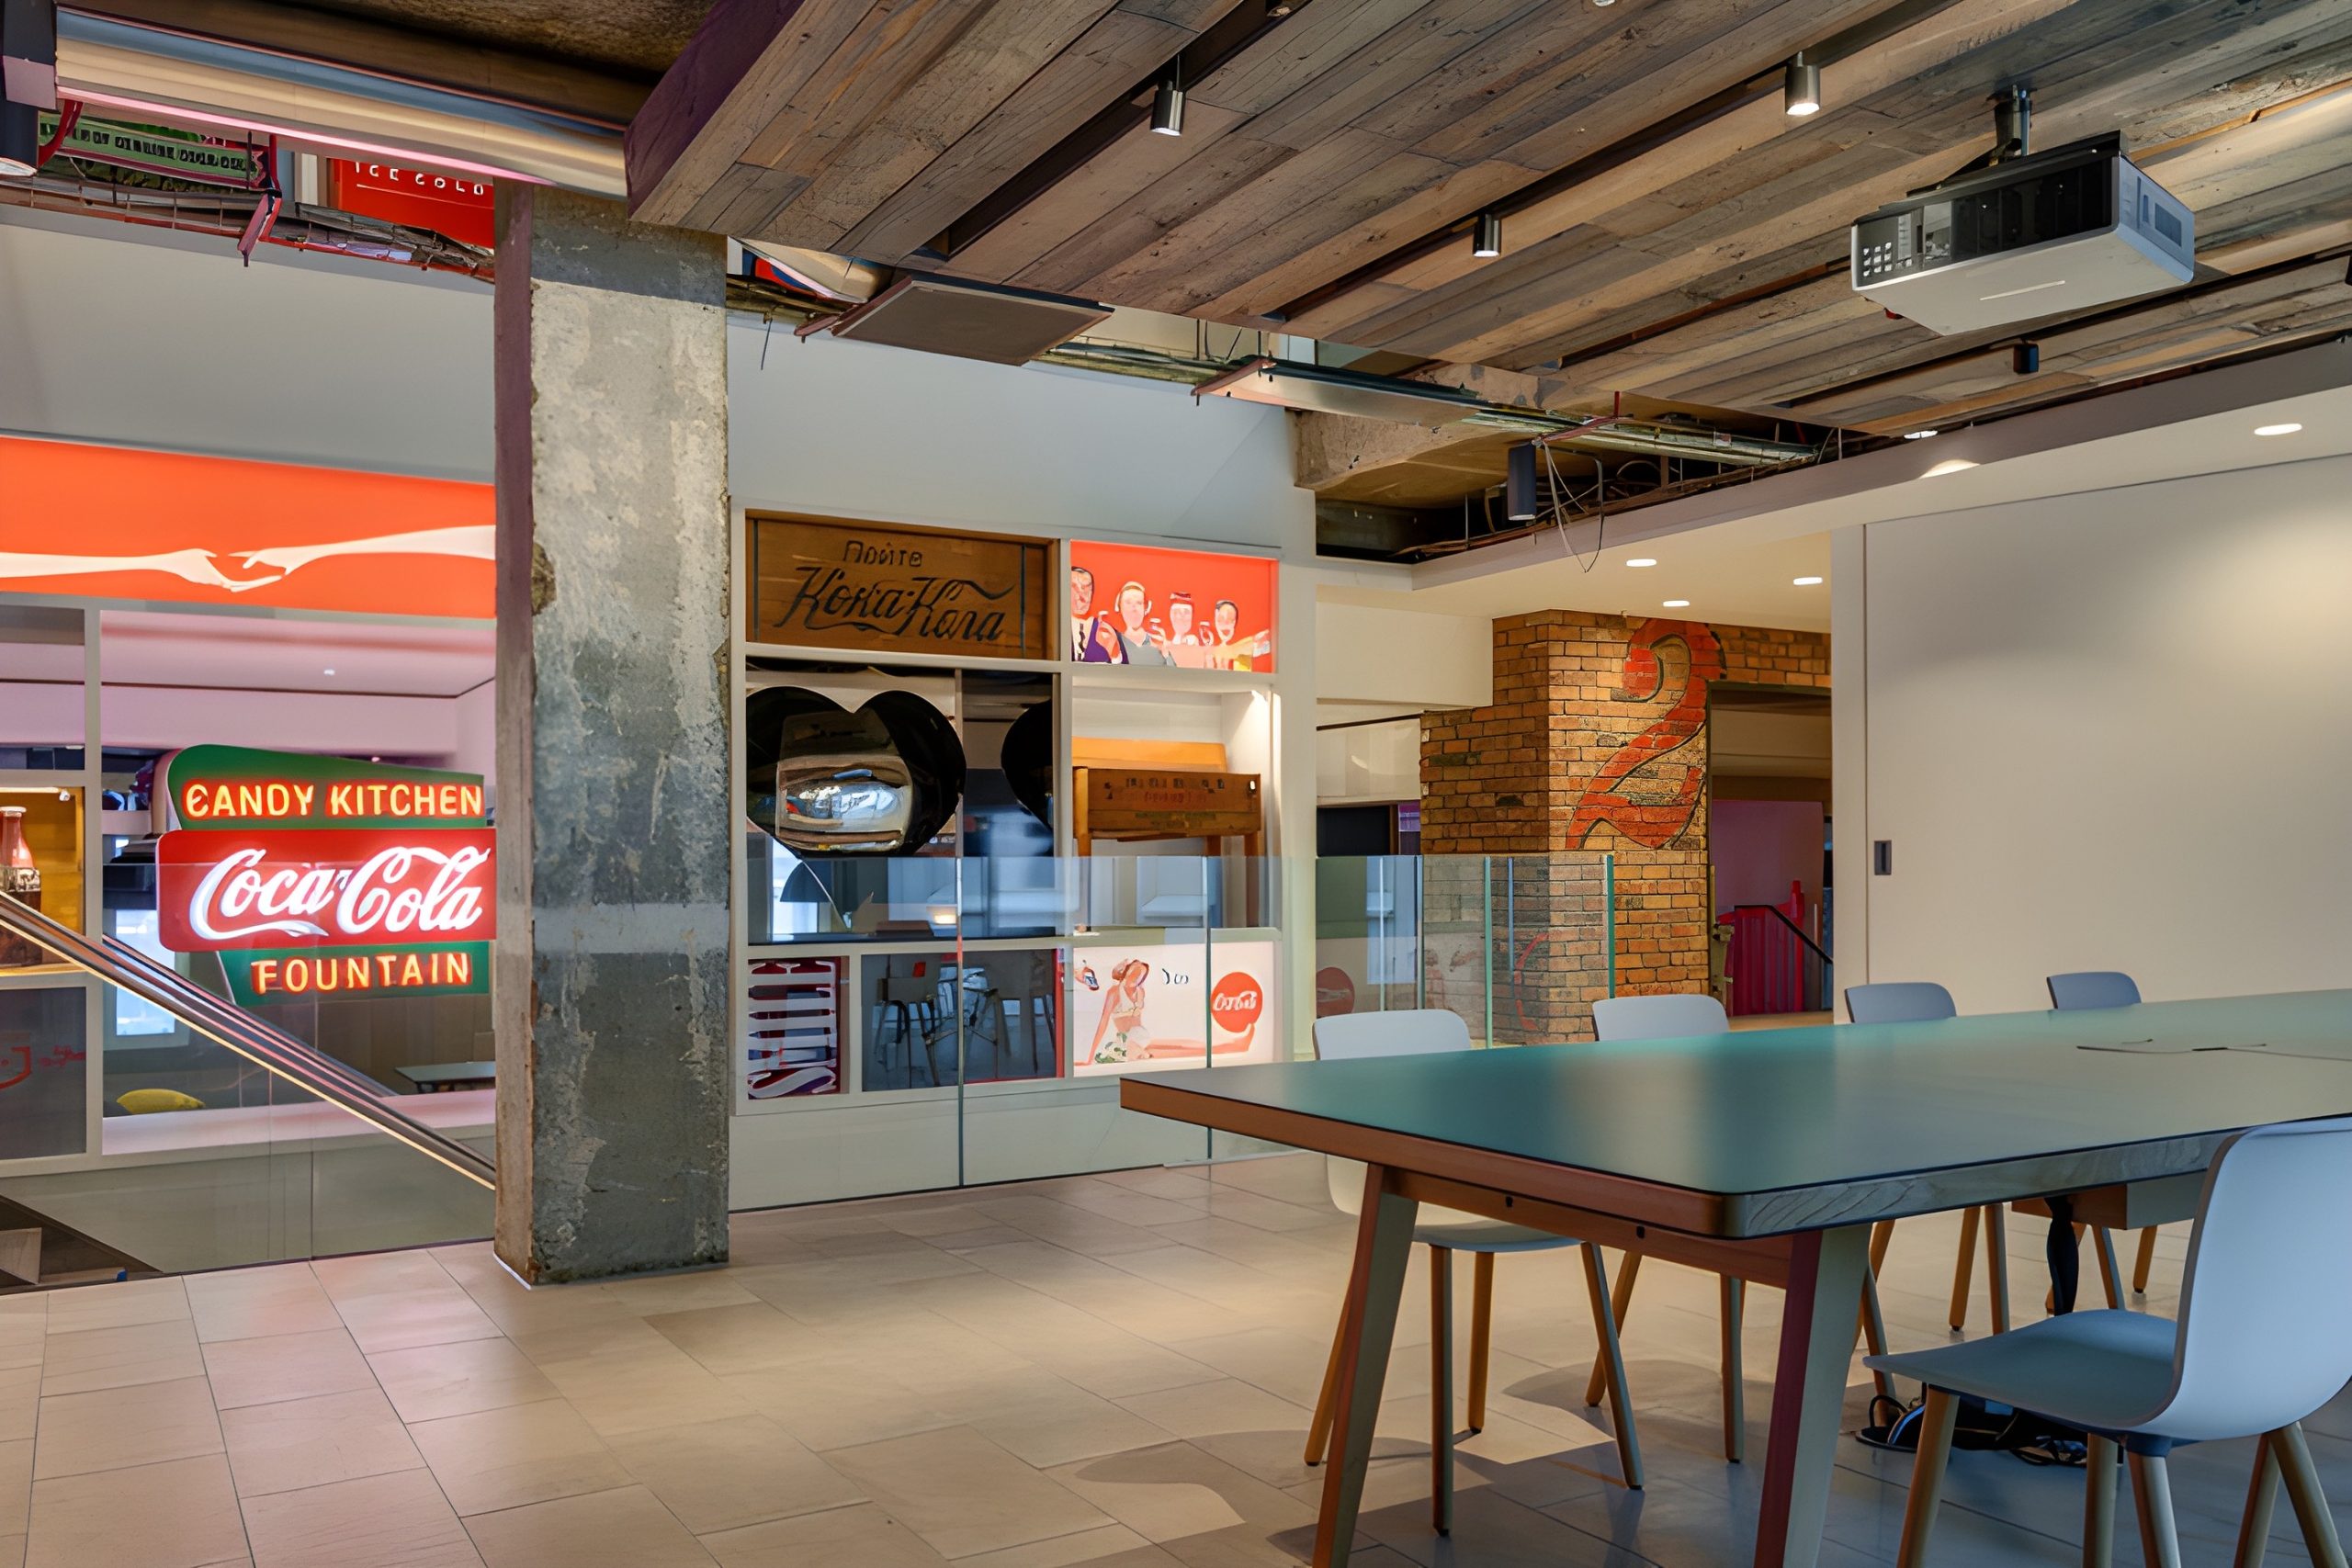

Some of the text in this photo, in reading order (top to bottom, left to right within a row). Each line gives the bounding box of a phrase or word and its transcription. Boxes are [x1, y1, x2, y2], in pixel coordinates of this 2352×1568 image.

[355, 162, 484, 196] ICE COLD
[186, 783, 483, 817] CANDY KITCHEN
[189, 846, 491, 941] Coca-Cola
[250, 953, 469, 995] FOUNTAIN
